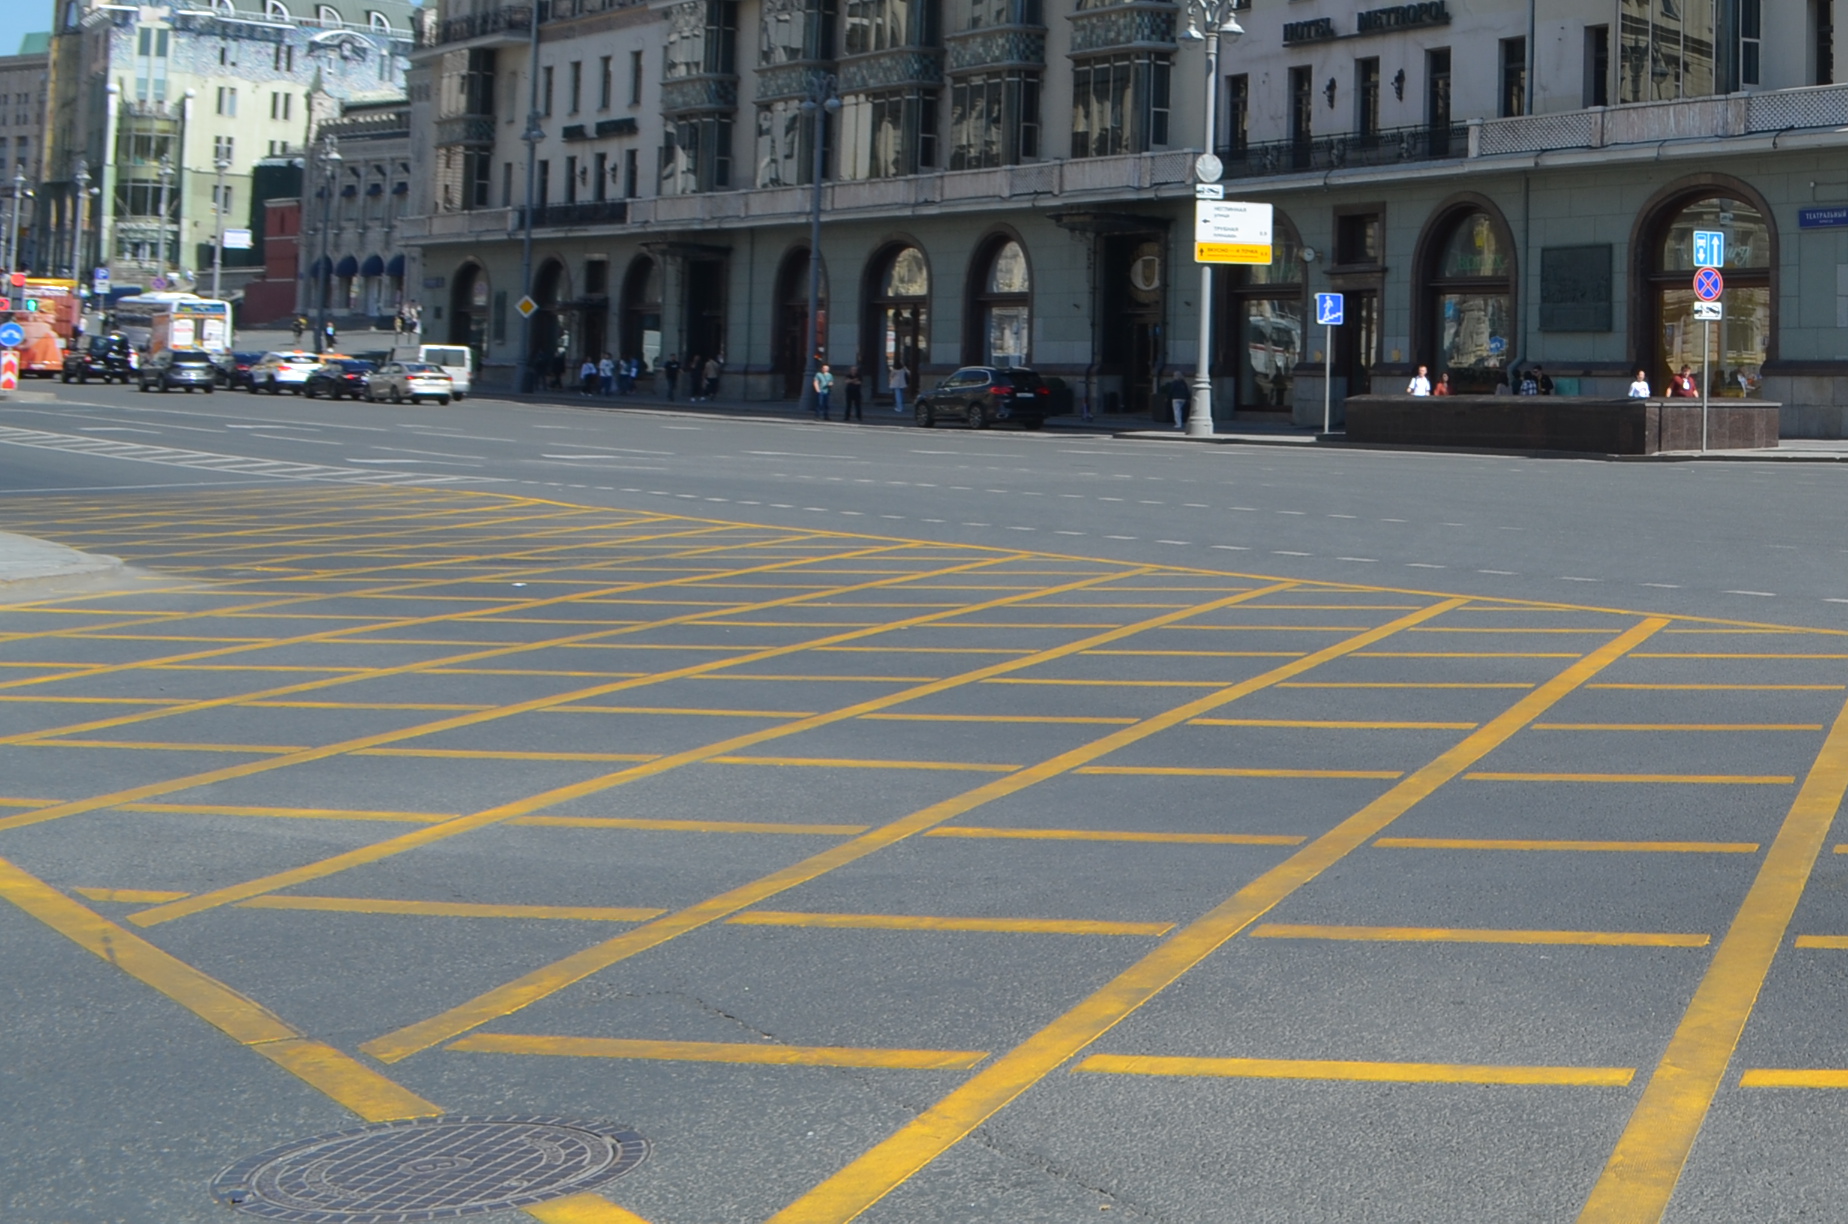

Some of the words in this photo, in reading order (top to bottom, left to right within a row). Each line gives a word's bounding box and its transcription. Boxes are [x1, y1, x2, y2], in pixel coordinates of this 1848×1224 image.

[1283, 17, 1336, 42] HOTEL
[1357, 0, 1450, 32] METROPOL
[1805, 209, 1847, 220] ТЕАТРАЛЬНЫЙ
